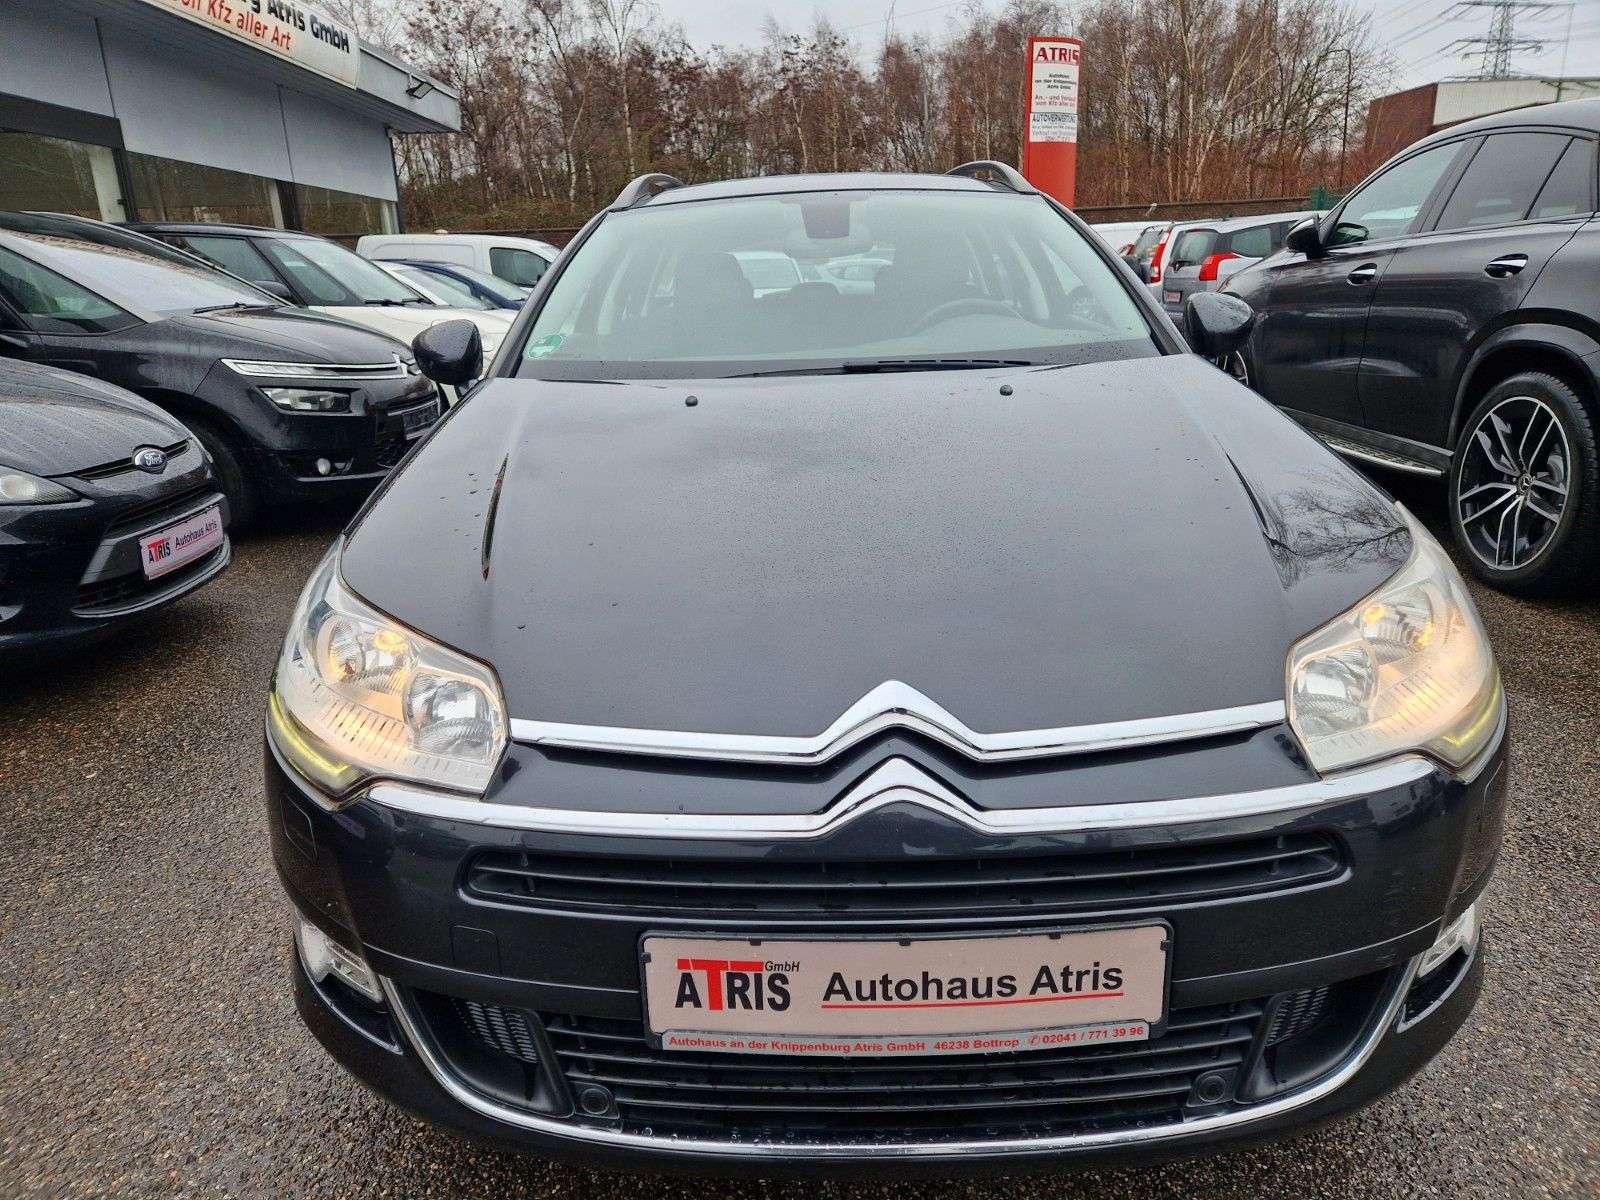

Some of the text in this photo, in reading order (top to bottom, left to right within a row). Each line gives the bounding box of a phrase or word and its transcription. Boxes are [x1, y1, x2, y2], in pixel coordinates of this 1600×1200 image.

[207, 0, 231, 24] Kfz
[236, 11, 268, 38] aller
[271, 26, 291, 50] Art
[267, 0, 350, 53] Atris GmbH
[147, 538, 171, 563] ATRIS
[175, 527, 204, 546] Autohaus
[675, 958, 800, 1012] ATRIS GmbH
[822, 961, 1124, 1002] Autohaus Atris
[668, 1036, 726, 1048] Autohaus
[729, 1039, 745, 1048] an
[748, 1038, 768, 1049] der
[771, 1040, 850, 1054] Knippenburg
[853, 1041, 883, 1052] Atris
[886, 1041, 925, 1052] GmbH
[933, 1040, 970, 1050] 46238
[973, 1037, 1020, 1050] Bottrop
[1041, 1032, 1077, 1044] 02041
[1088, 1029, 1108, 1039] 771
[1111, 1027, 1127, 1038] 39
[1129, 1026, 1144, 1036] 96
